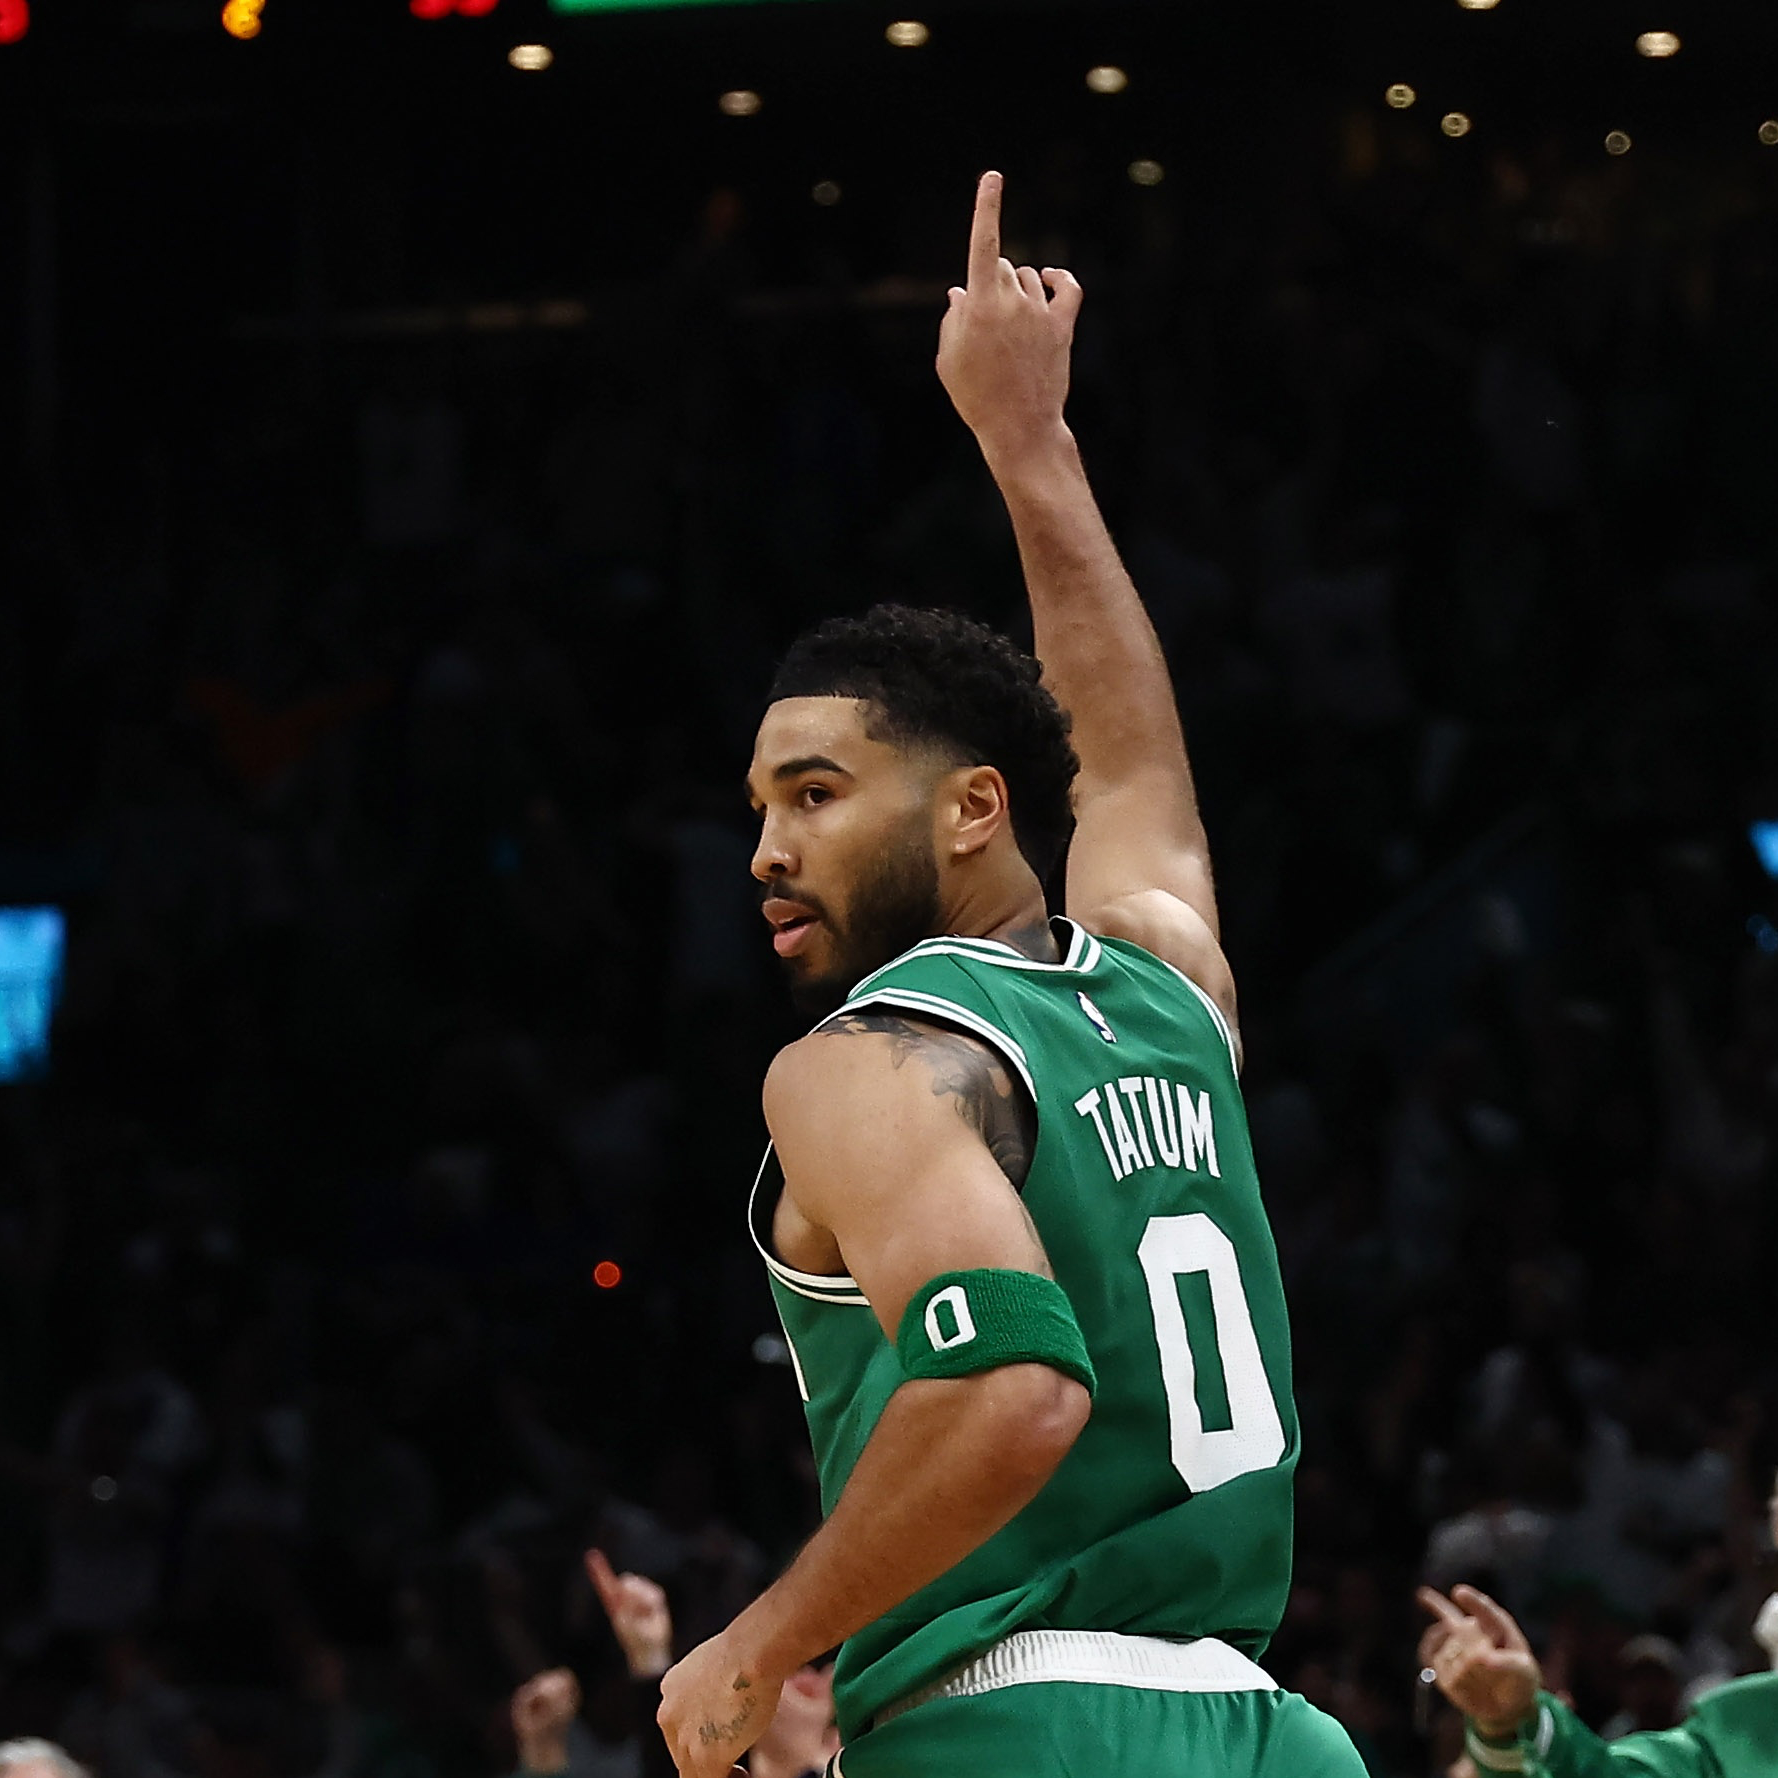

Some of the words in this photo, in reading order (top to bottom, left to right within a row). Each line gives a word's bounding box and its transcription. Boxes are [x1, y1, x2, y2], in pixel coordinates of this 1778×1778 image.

[1075, 1076, 1221, 1182] TATUM
[924, 1285, 977, 1351] 0
[1137, 1213, 1285, 1494] 0
